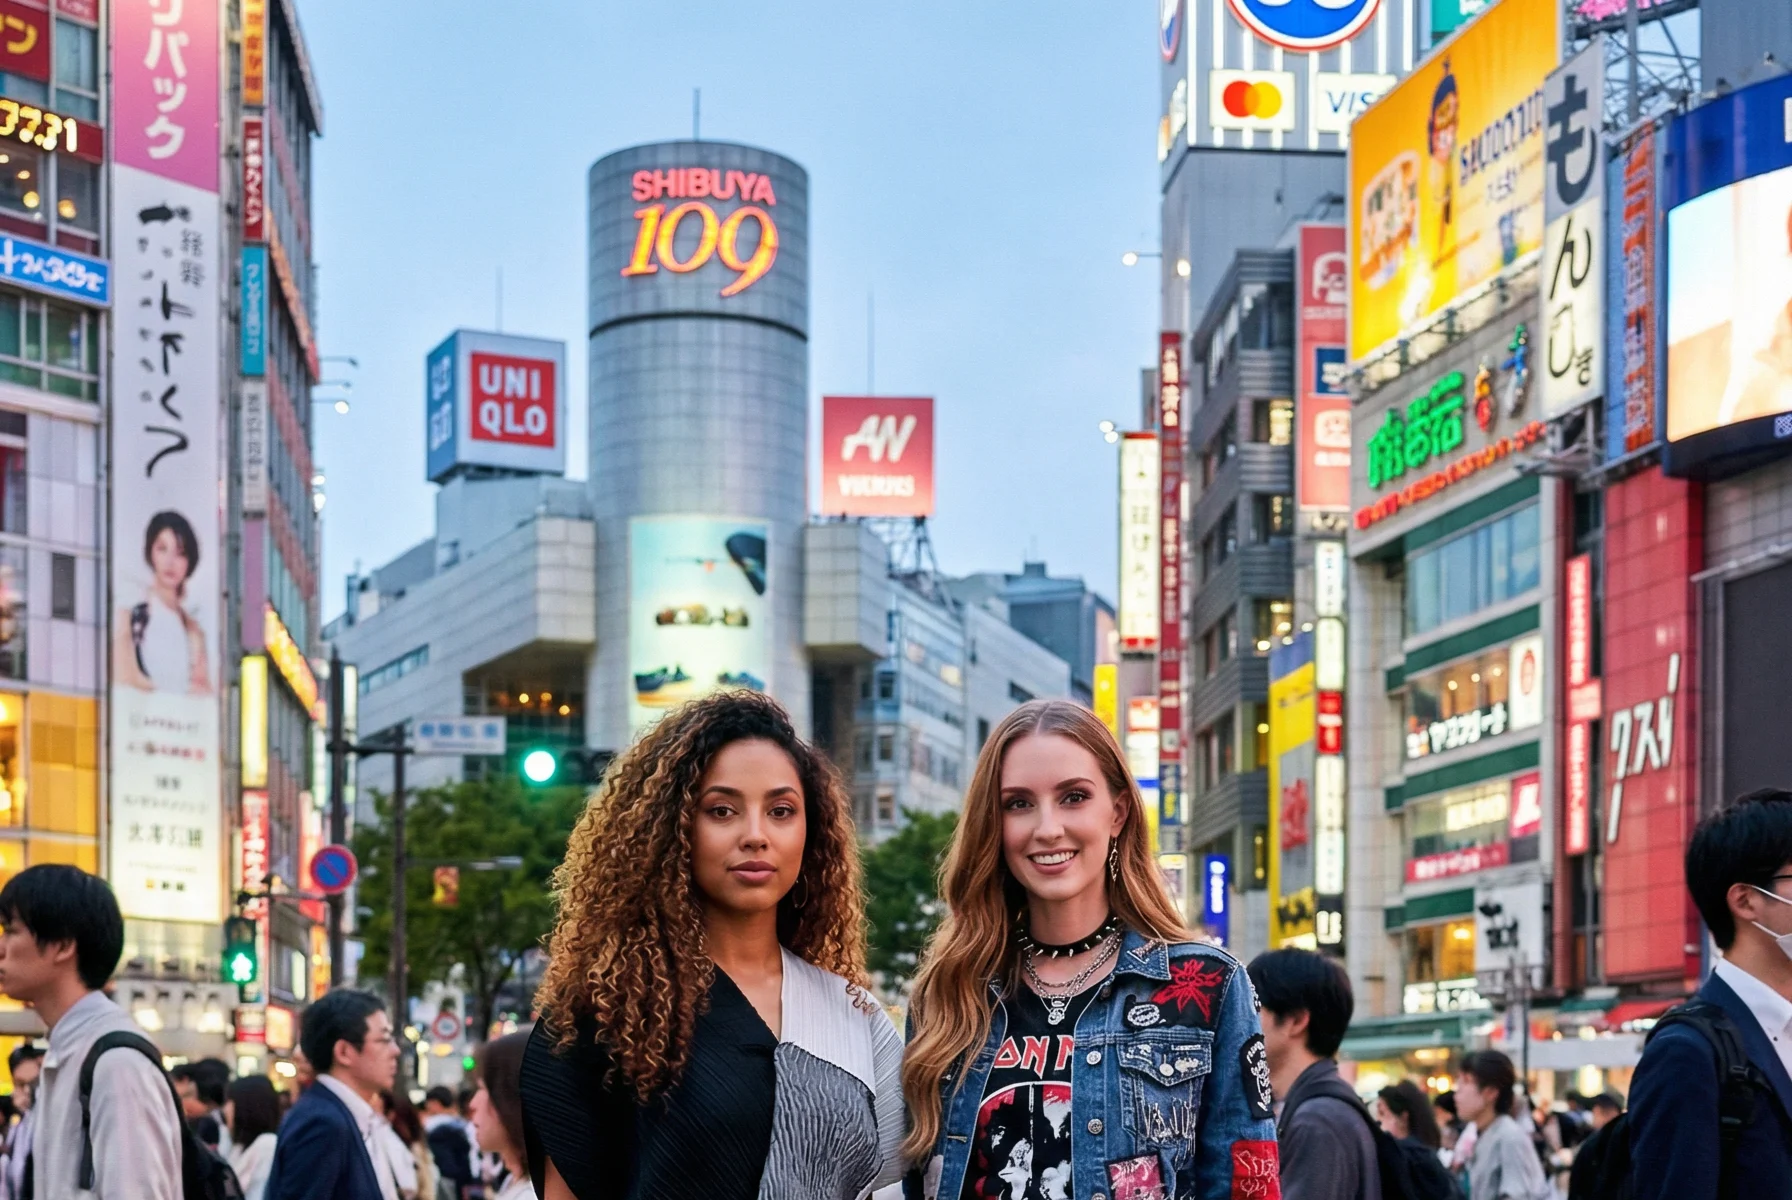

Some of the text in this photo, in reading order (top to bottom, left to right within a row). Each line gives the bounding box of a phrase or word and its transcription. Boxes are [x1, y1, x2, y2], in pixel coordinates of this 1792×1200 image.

[1325, 90, 1377, 114] VIS
[632, 167, 777, 206] SHIBUYA
[620, 201, 779, 297] 109
[479, 363, 541, 400] UNI
[479, 399, 548, 437] QLO
